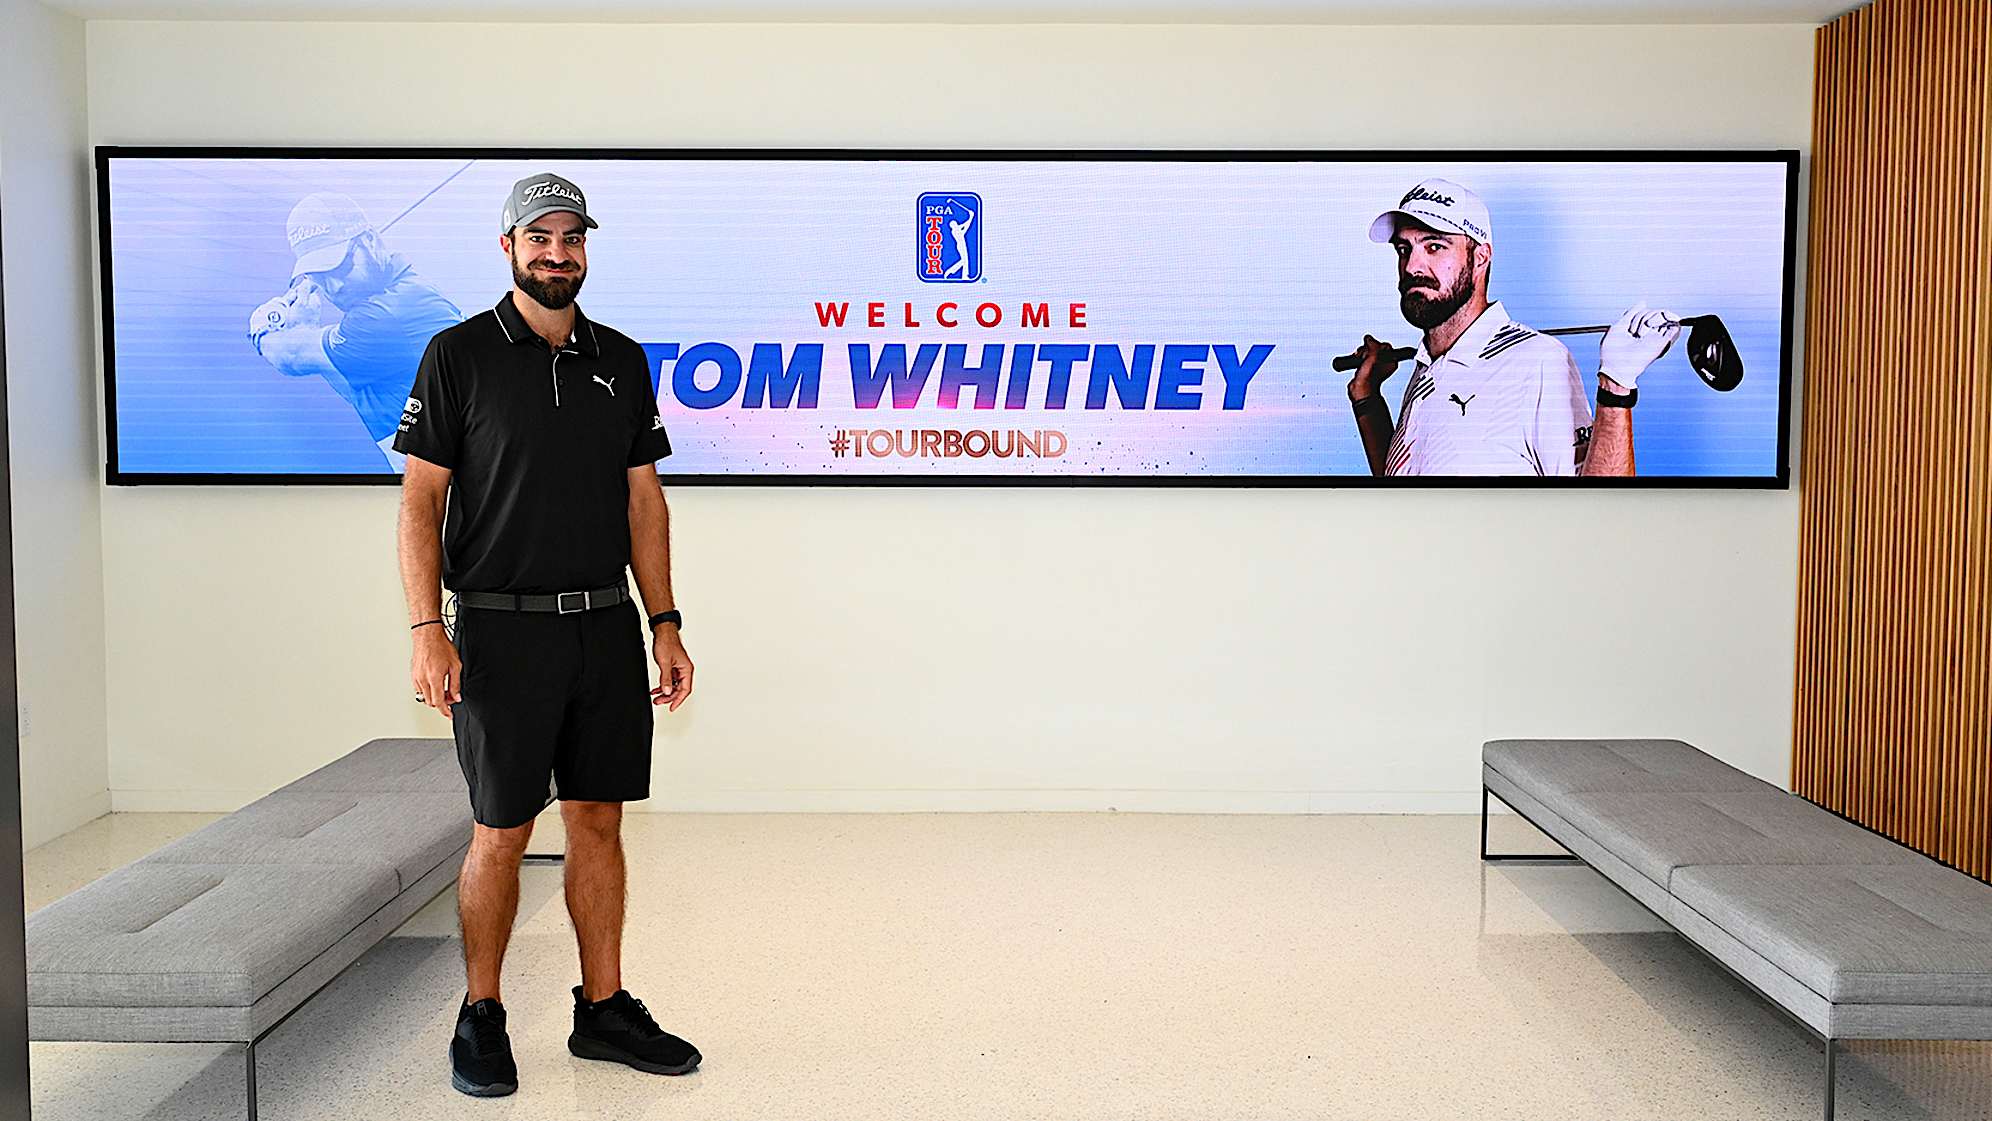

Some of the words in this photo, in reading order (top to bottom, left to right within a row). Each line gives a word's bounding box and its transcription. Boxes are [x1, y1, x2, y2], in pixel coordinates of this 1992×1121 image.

[521, 181, 583, 206] Titleist
[926, 205, 953, 215] PGA
[926, 216, 943, 274] TOUR
[814, 302, 1087, 328] WELCOME
[640, 343, 824, 410] TOM
[848, 343, 1276, 411] WHITNEY
[829, 429, 1068, 458] #TOURBOUND
